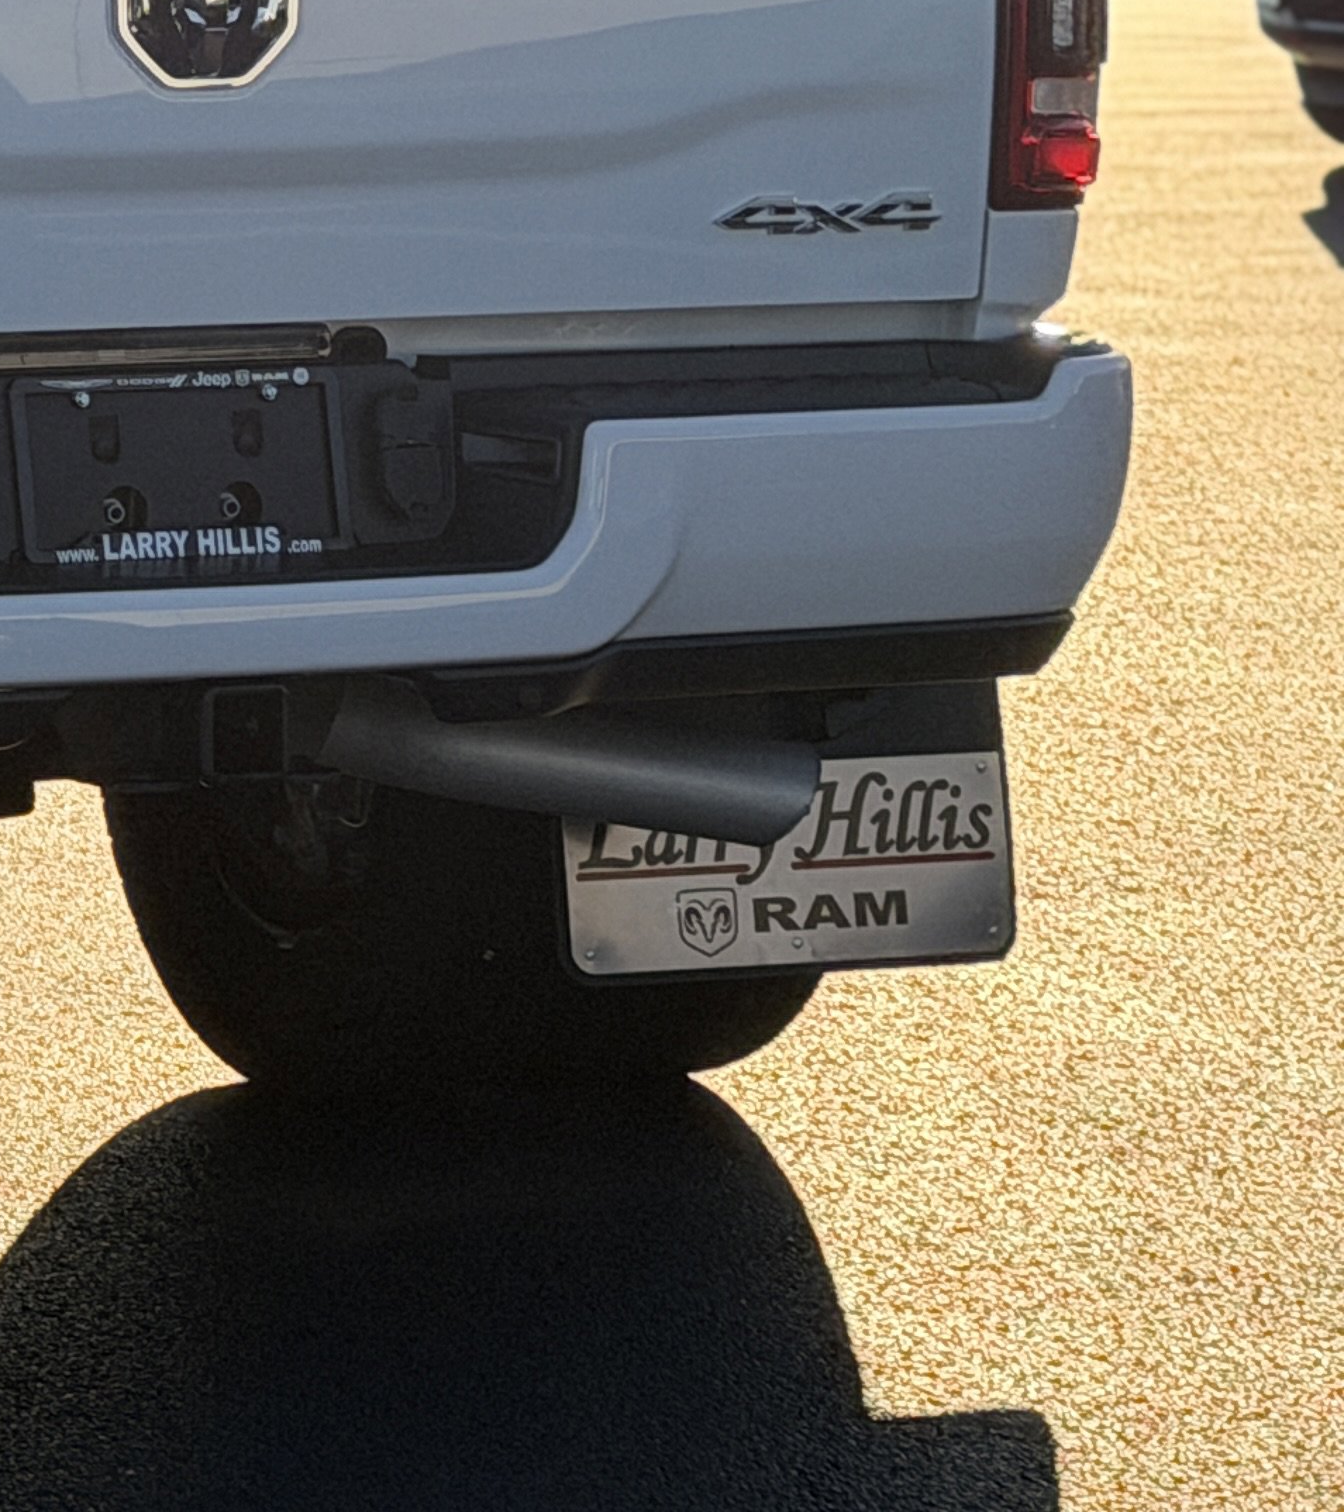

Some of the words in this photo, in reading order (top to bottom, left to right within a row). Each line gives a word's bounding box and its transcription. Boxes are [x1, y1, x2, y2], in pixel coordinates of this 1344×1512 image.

[192, 370, 231, 388] Jeep
[55, 546, 100, 564] www.
[102, 529, 189, 561] LARRY
[196, 525, 282, 557] HILLIS
[287, 538, 323, 555] .com
[793, 771, 994, 859] Hillis
[752, 889, 910, 933] RAM
